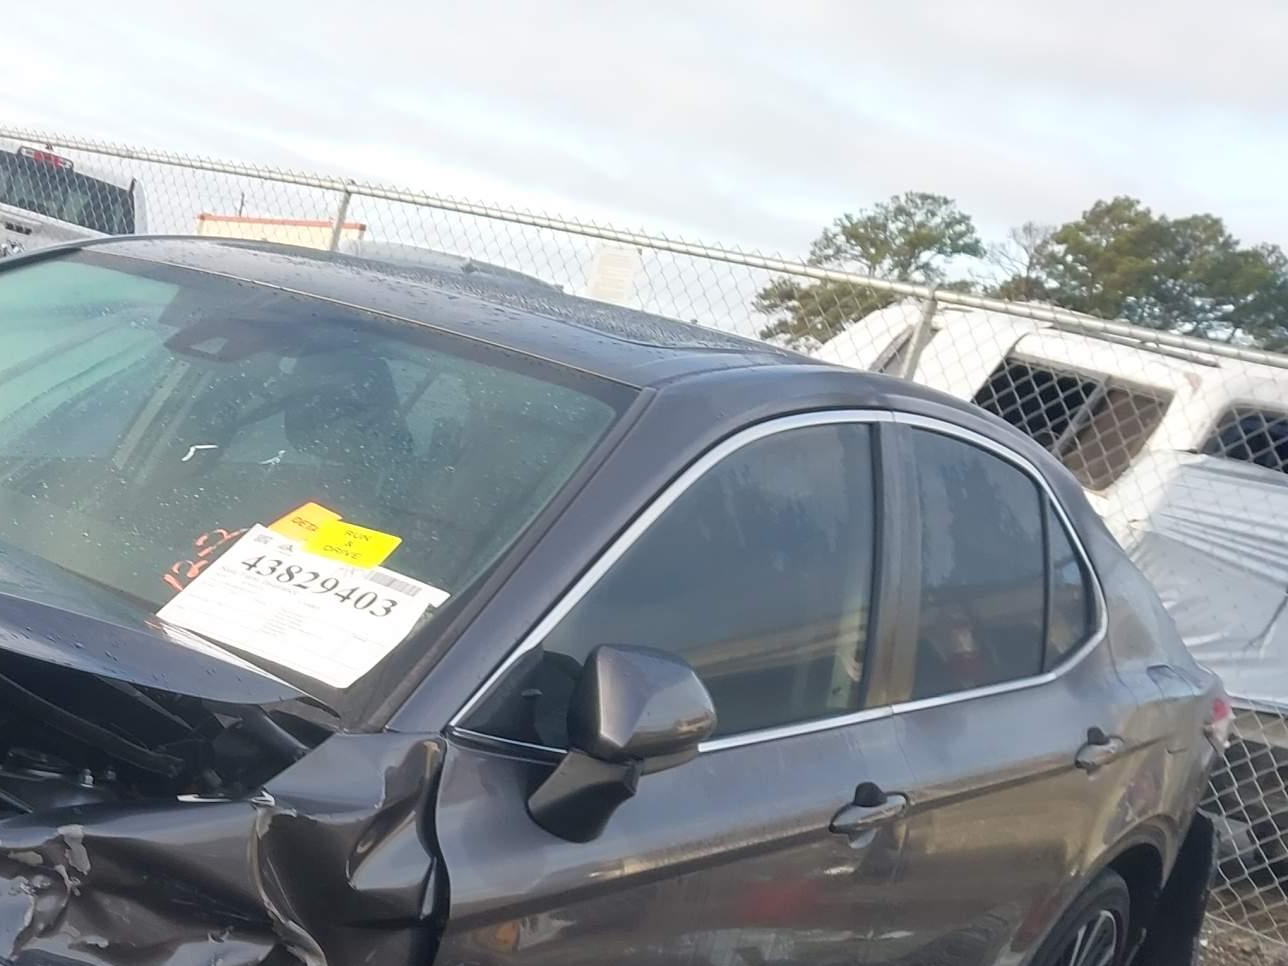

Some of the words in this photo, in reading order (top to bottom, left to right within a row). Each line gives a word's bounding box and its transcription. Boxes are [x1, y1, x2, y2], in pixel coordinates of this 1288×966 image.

[345, 529, 372, 543] RUN
[322, 544, 361, 560] DRIVE
[240, 555, 398, 618] 43829403
